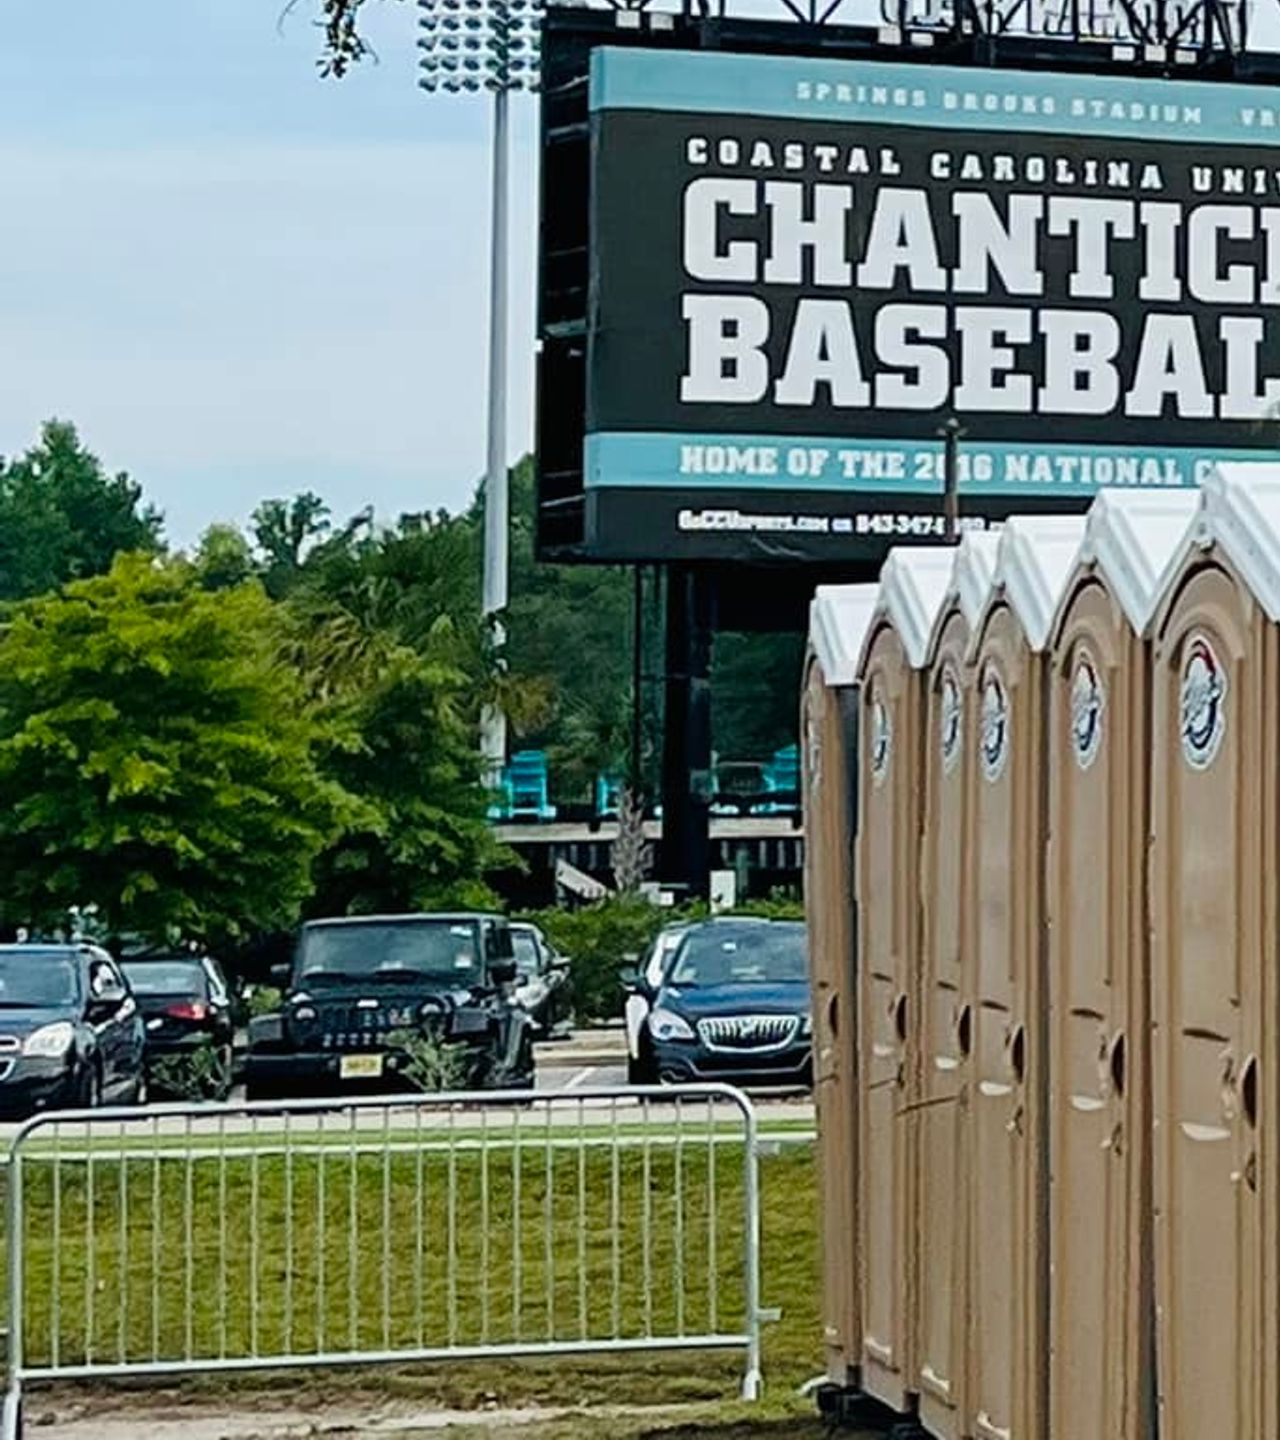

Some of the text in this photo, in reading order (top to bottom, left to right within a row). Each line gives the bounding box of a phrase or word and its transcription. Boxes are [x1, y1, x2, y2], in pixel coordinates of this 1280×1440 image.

[797, 81, 927, 107] SPRINGS
[943, 92, 1055, 116] BROOKS
[1071, 98, 1202, 125] STADIUM
[686, 138, 901, 176] COASTAL
[930, 152, 1163, 190] CAROLINA
[679, 444, 779, 475] HOME
[786, 447, 830, 477] OF
[837, 449, 905, 479] THE
[1003, 453, 1183, 486] NATIONAL
